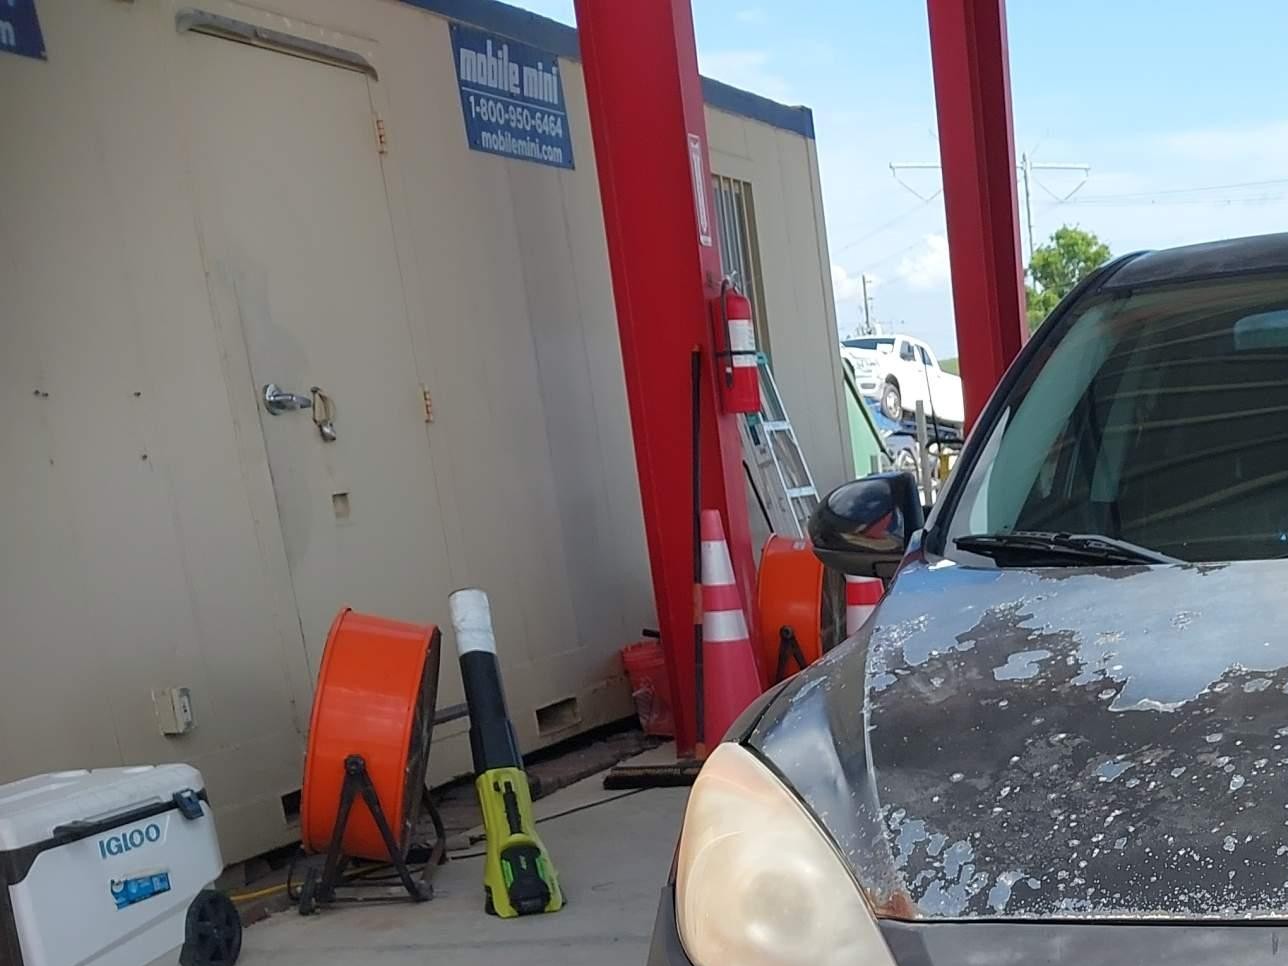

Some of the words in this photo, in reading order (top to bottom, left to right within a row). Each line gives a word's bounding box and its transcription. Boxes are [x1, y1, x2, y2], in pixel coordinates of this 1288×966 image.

[460, 39, 520, 94] mobile
[523, 62, 558, 105] mini
[469, 95, 562, 138] 1-800-950-6464
[481, 130, 562, 162] mobilemini.com
[99, 825, 160, 858] IGLOO
